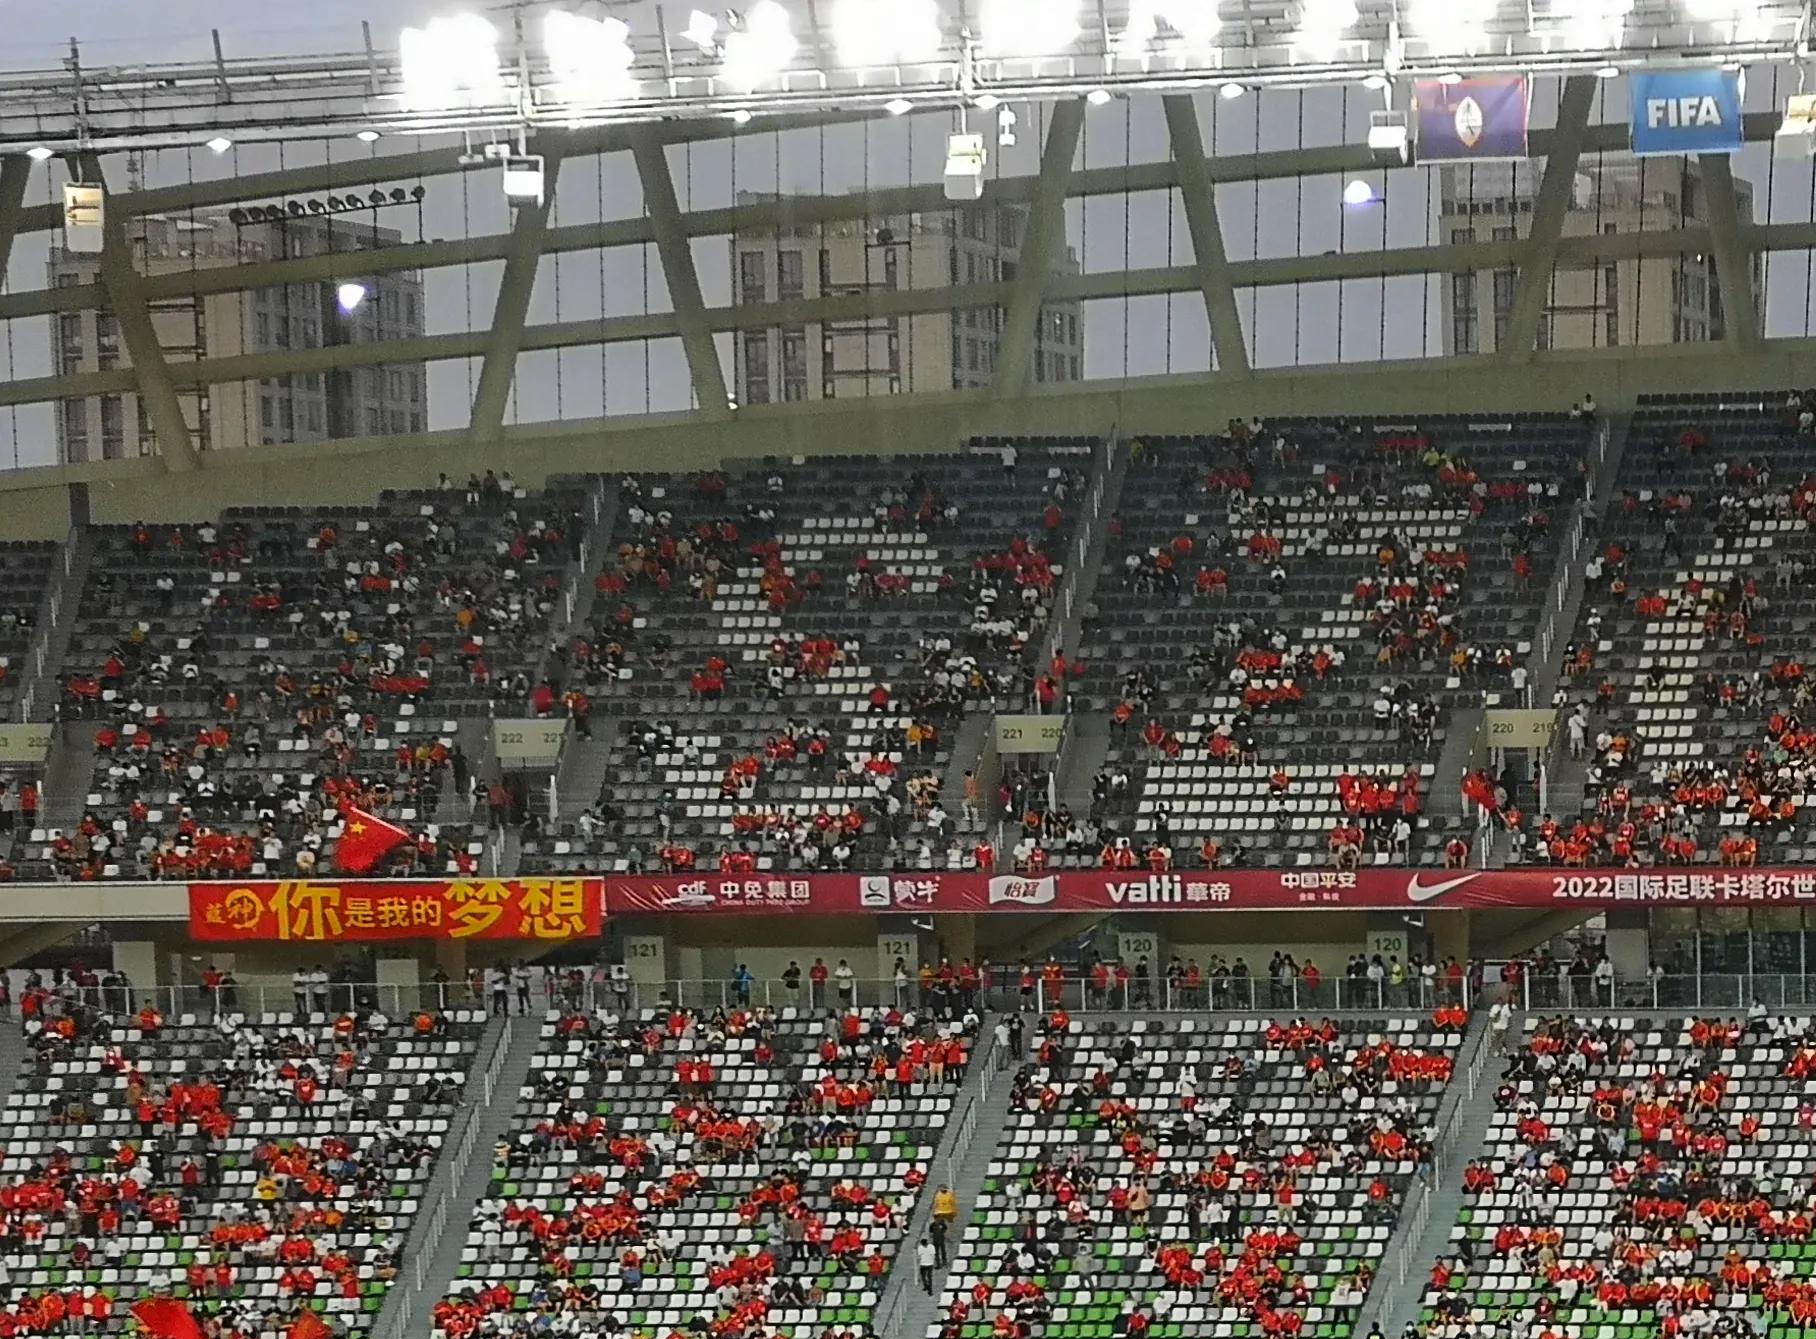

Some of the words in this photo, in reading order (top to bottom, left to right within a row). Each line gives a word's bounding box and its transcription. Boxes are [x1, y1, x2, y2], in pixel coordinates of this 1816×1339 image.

[1647, 96, 1721, 128] FIFA
[1002, 729, 1024, 740] 221
[1492, 723, 1514, 733] 220
[501, 732, 523, 744] 222
[1281, 872, 1357, 888] 中国平安
[720, 880, 810, 899] 中免集团
[1105, 875, 1181, 904] vatti
[268, 879, 587, 940] 你是我的梦想
[630, 943, 656, 956] 121
[884, 942, 911, 955] 121
[1124, 938, 1152, 951] 120
[1374, 938, 1402, 951] 120
